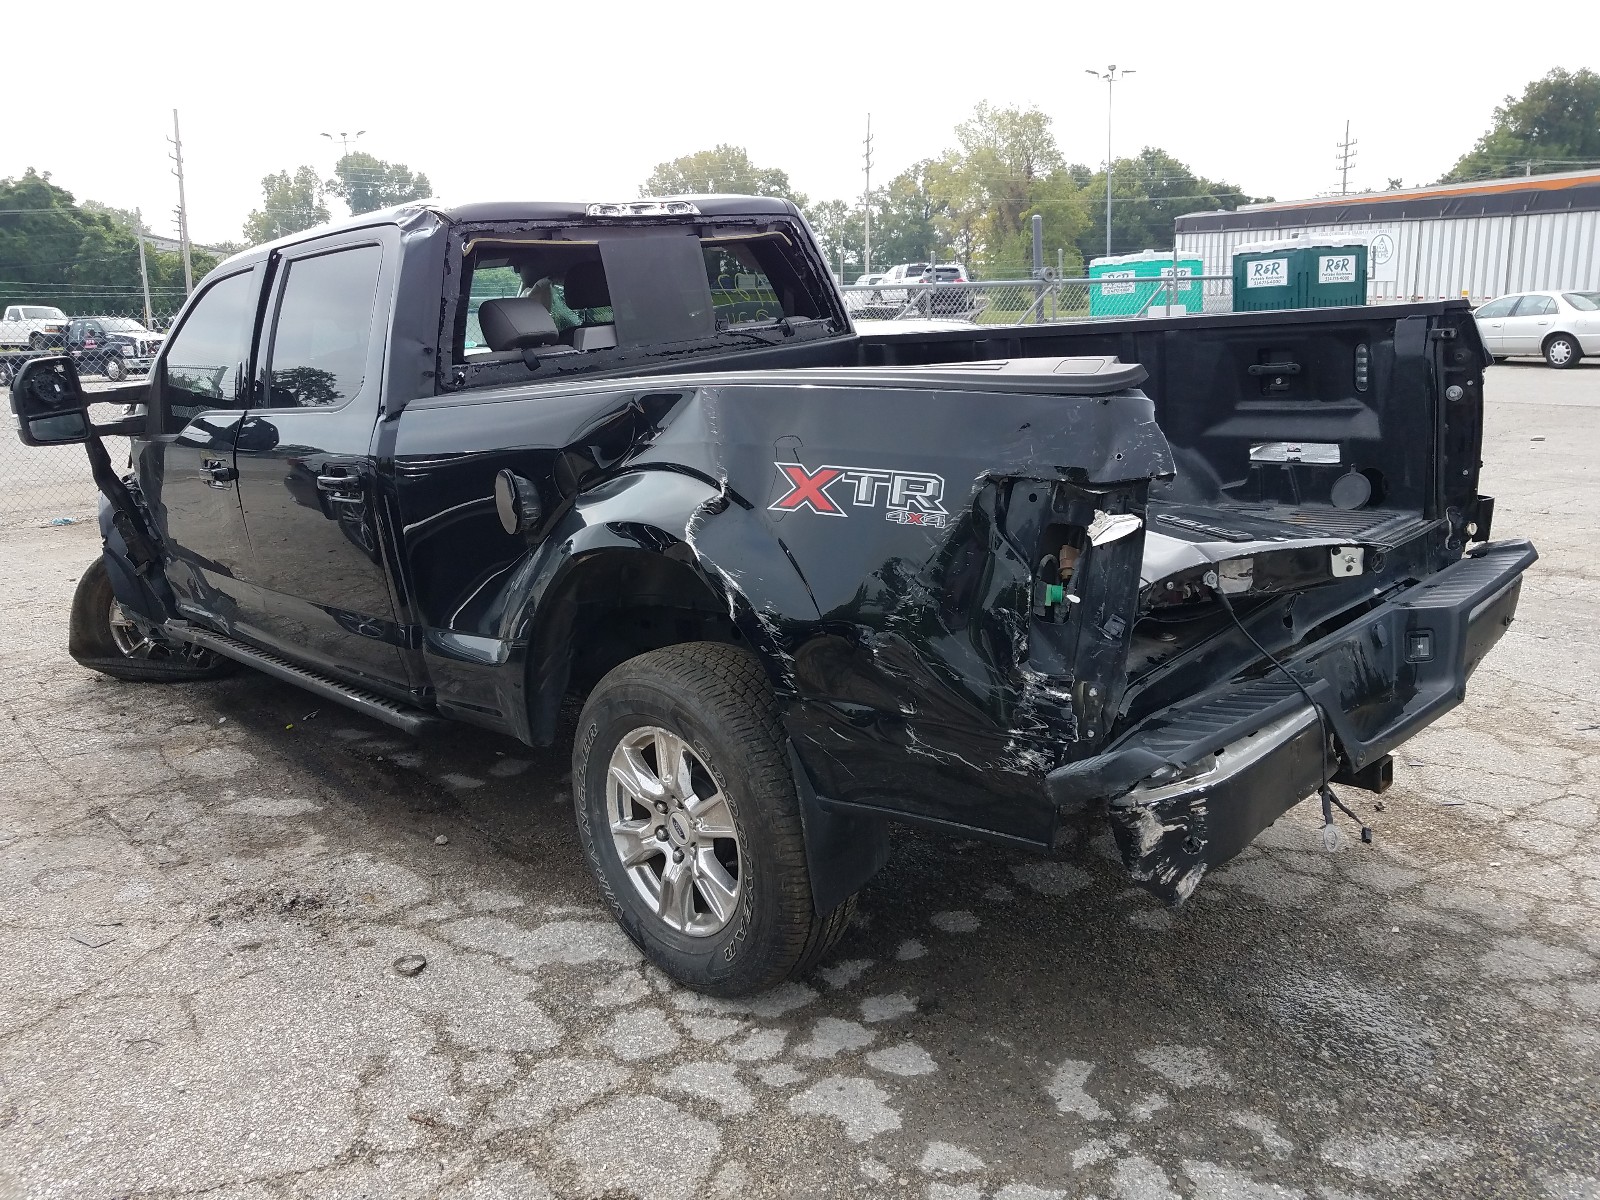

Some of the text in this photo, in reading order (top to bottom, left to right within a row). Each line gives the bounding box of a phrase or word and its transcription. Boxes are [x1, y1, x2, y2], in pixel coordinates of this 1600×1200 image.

[1254, 262, 1281, 276] R&R
[1325, 258, 1350, 272] R&R
[767, 462, 949, 517] XTR
[693, 738, 755, 961] GOODYEAR
